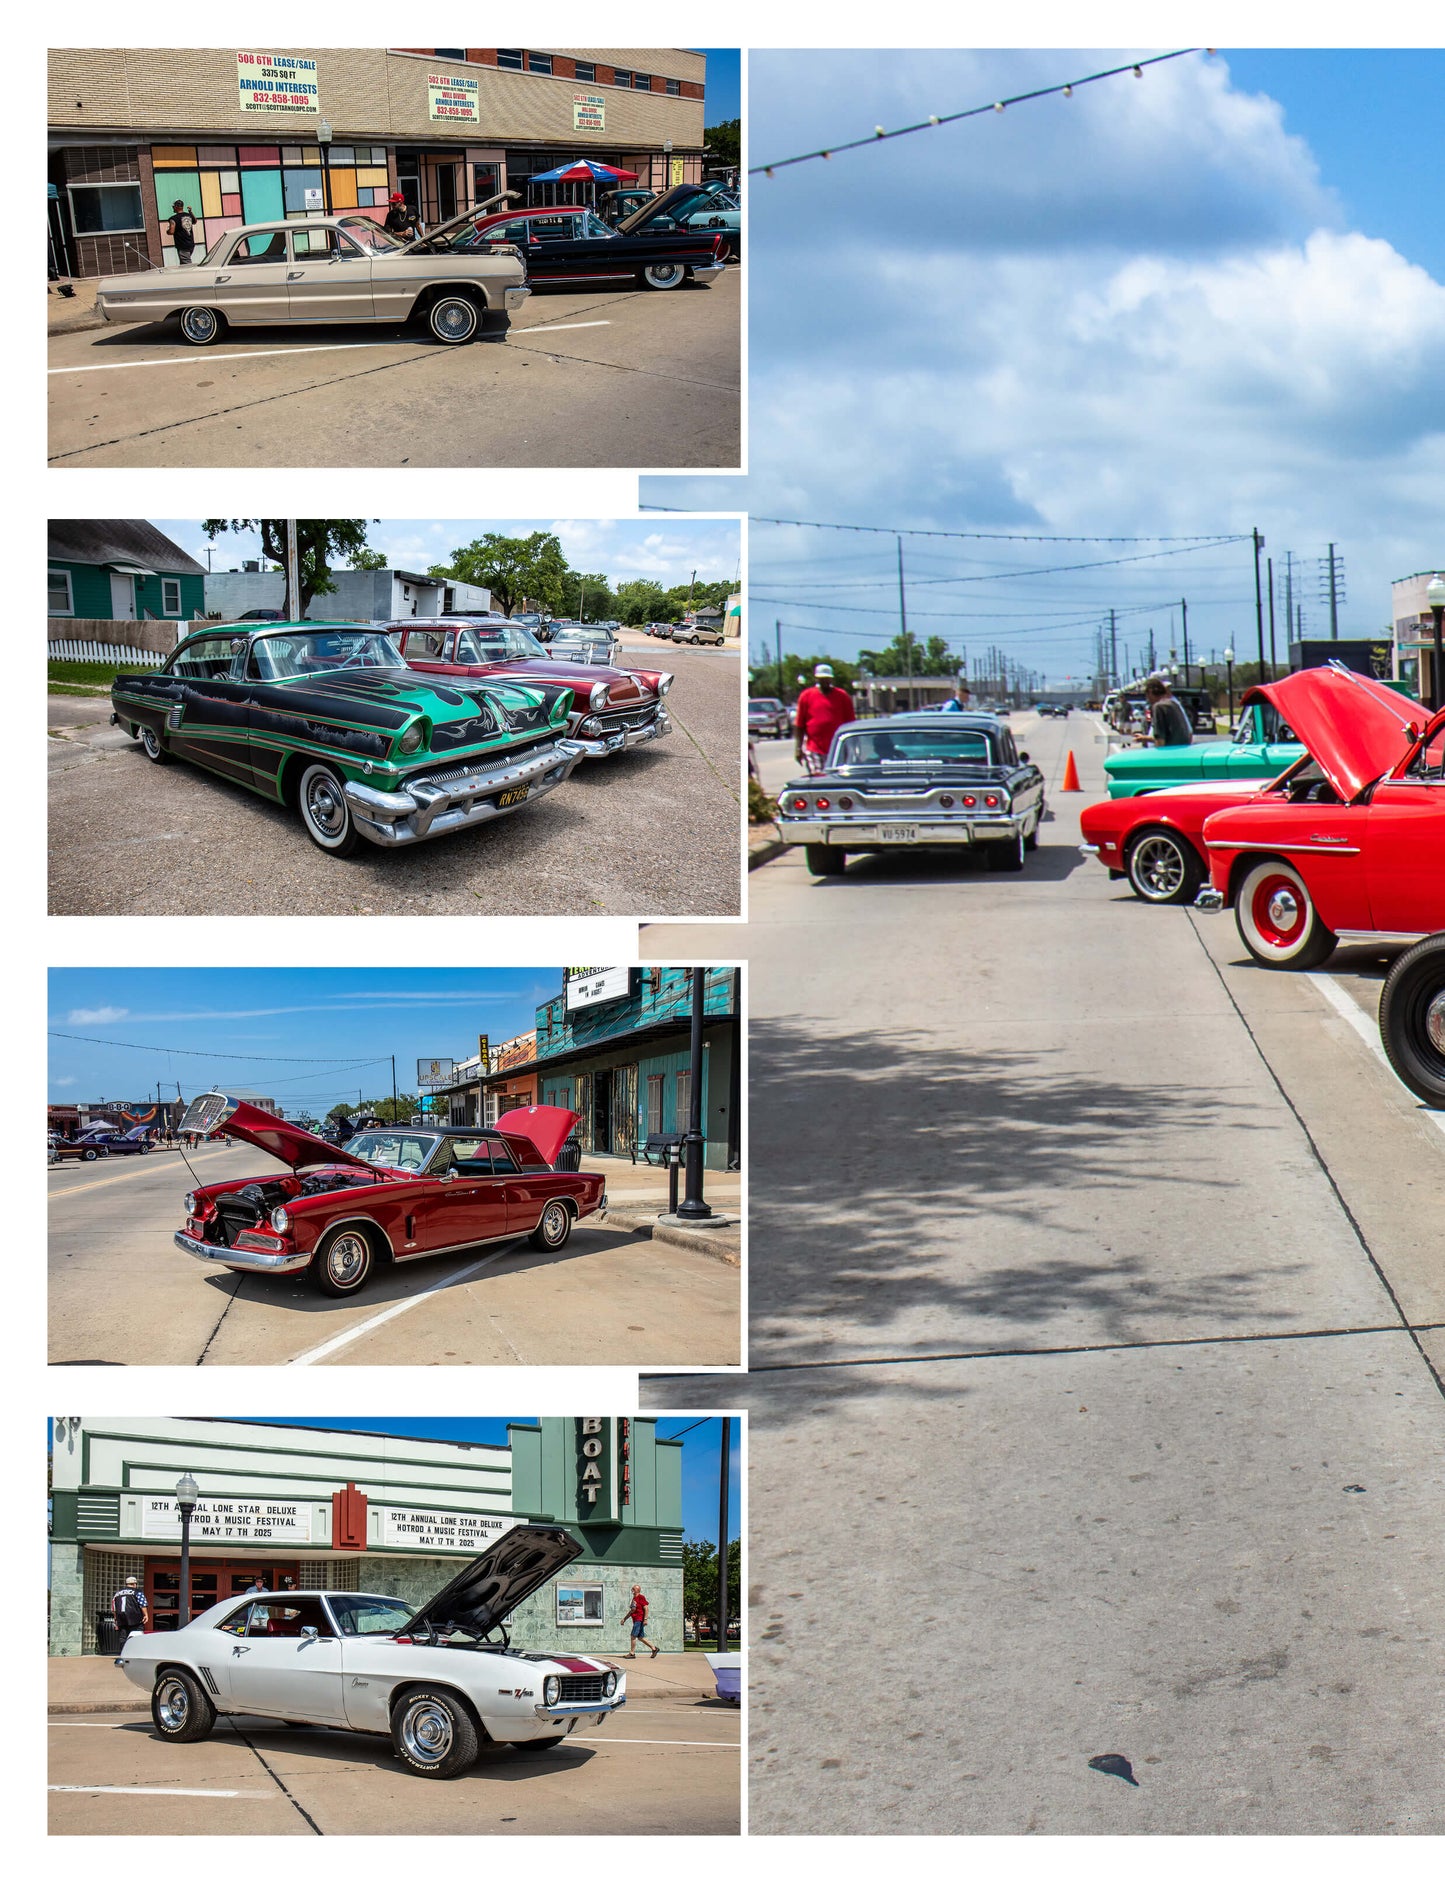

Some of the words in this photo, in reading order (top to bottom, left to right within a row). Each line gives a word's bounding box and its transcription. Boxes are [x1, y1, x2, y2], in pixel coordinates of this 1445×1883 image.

[238, 54, 254, 64] 508
[256, 55, 272, 66] 6TH
[273, 57, 316, 70] LEASE/SALE
[262, 68, 278, 78] 3375
[279, 71, 288, 79] SQ
[289, 71, 296, 79] FT
[240, 79, 274, 91] ARNOLD
[275, 82, 317, 94] INTERESTS
[253, 92, 309, 105] 832-858-1095
[151, 1502, 169, 1511] 12TH
[213, 1504, 233, 1513] LONE
[238, 1505, 260, 1514] STAR
[267, 1506, 297, 1515] DELUXE
[178, 1515, 211, 1523] HTROD
[215, 1516, 220, 1524] &
[225, 1516, 251, 1525] MUSIC
[257, 1518, 296, 1526] FESTIVAL
[391, 1513, 406, 1521] 12TH
[411, 1514, 437, 1524] ANNUAL
[441, 1517, 457, 1525] LONE
[460, 1518, 477, 1527] STAR
[481, 1520, 502, 1529] DELUXE
[202, 1527, 220, 1536] MAY
[226, 1528, 233, 1536] 17
[238, 1529, 248, 1537] TH
[254, 1529, 272, 1537] 2025
[397, 1524, 424, 1533] HOTROD
[434, 1526, 455, 1535] MUSIC
[458, 1528, 488, 1538] FESTIVAL
[460, 1539, 475, 1547] 2025
[121, 1595, 127, 1612] 1
